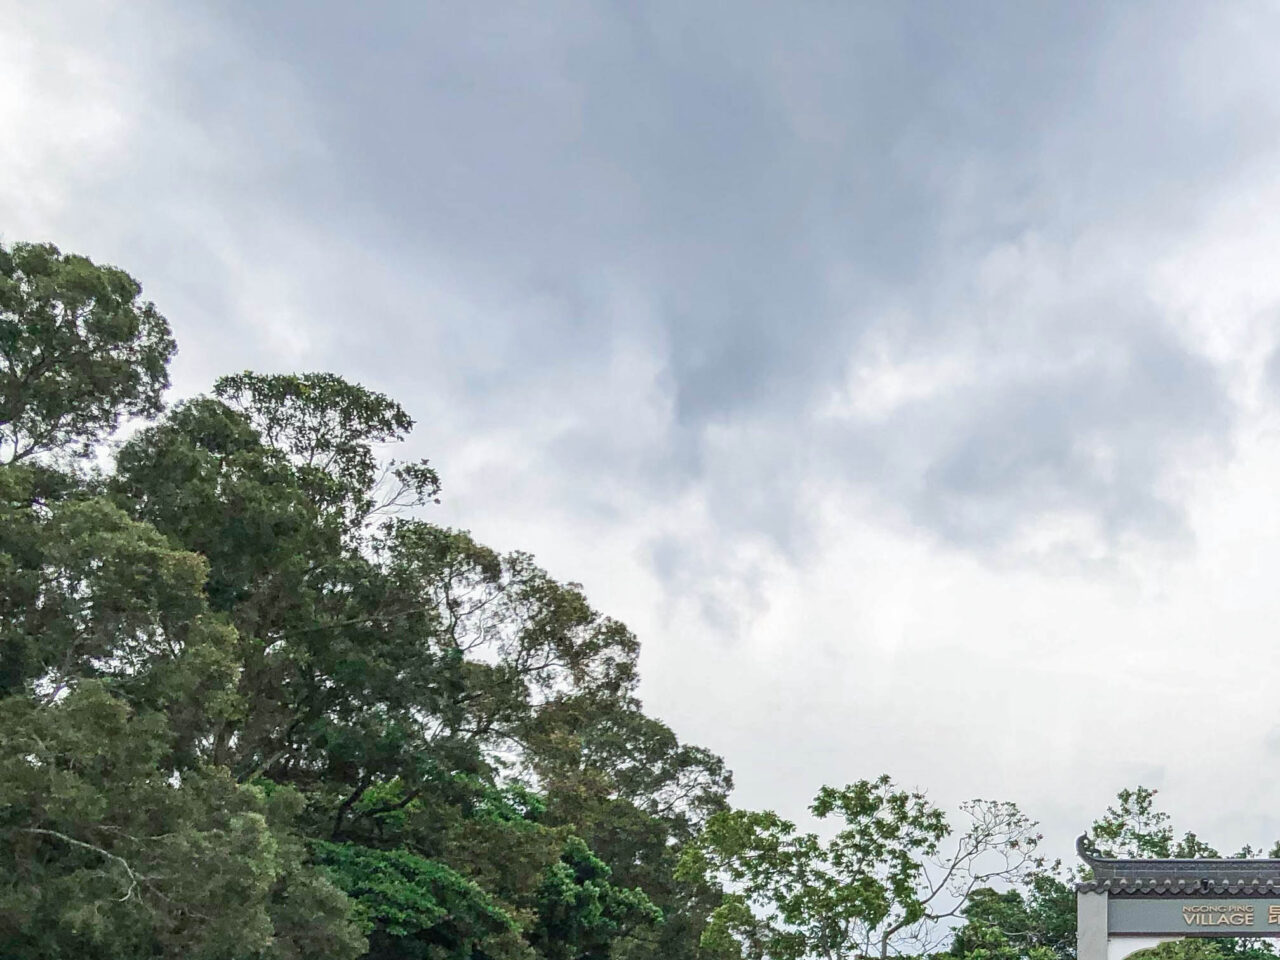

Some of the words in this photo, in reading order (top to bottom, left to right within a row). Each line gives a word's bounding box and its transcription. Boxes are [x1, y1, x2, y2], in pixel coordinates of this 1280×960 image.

[1182, 905, 1226, 913] NGONG
[1228, 905, 1255, 913] PING
[1183, 913, 1255, 926] VILLAGE
